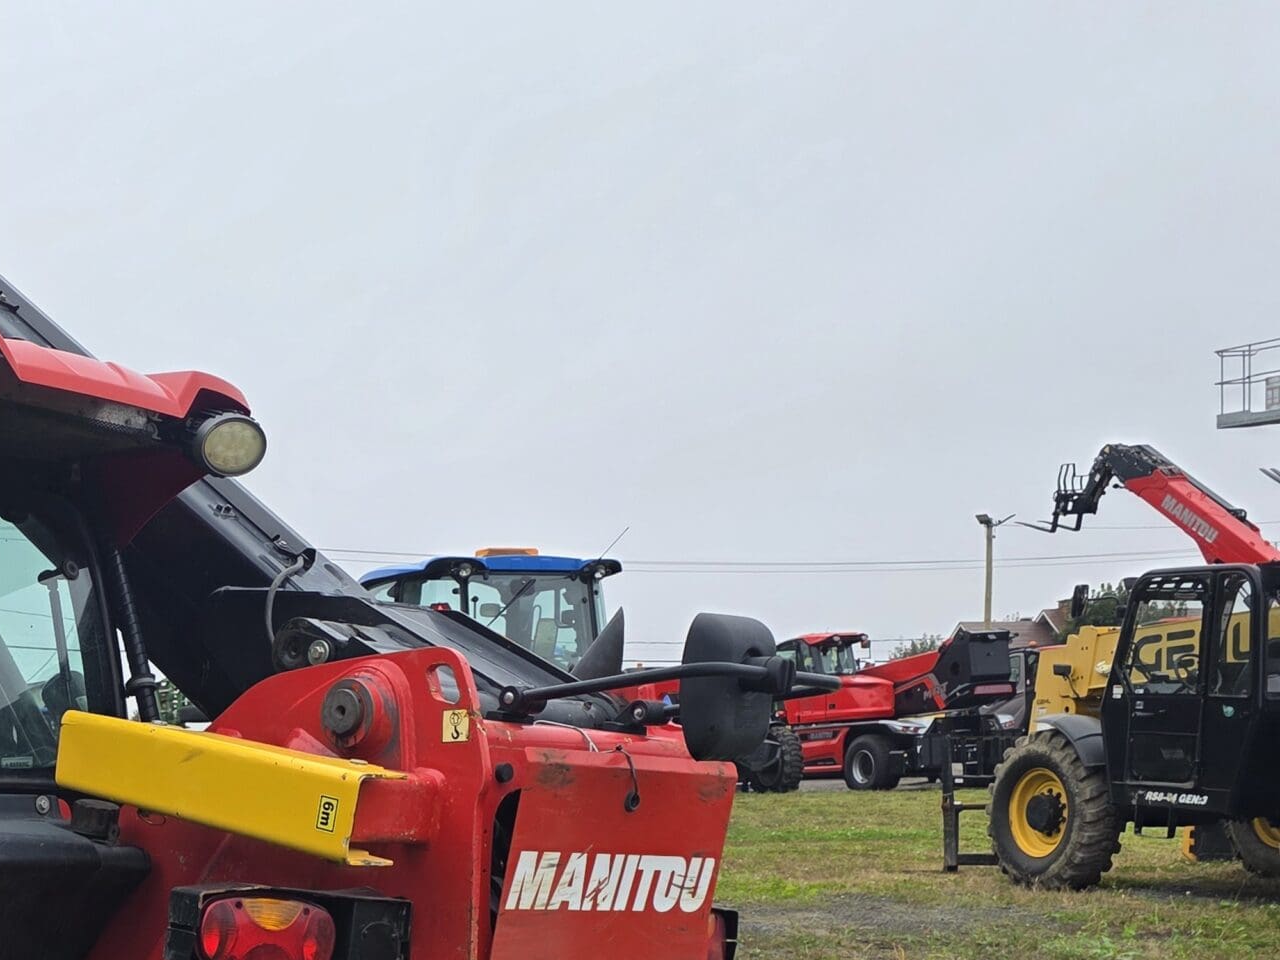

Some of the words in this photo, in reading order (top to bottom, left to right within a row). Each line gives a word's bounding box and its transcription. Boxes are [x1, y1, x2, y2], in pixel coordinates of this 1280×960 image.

[1161, 494, 1218, 543] MANITOU
[320, 801, 334, 826] 6m
[504, 851, 716, 913] MANITOU
